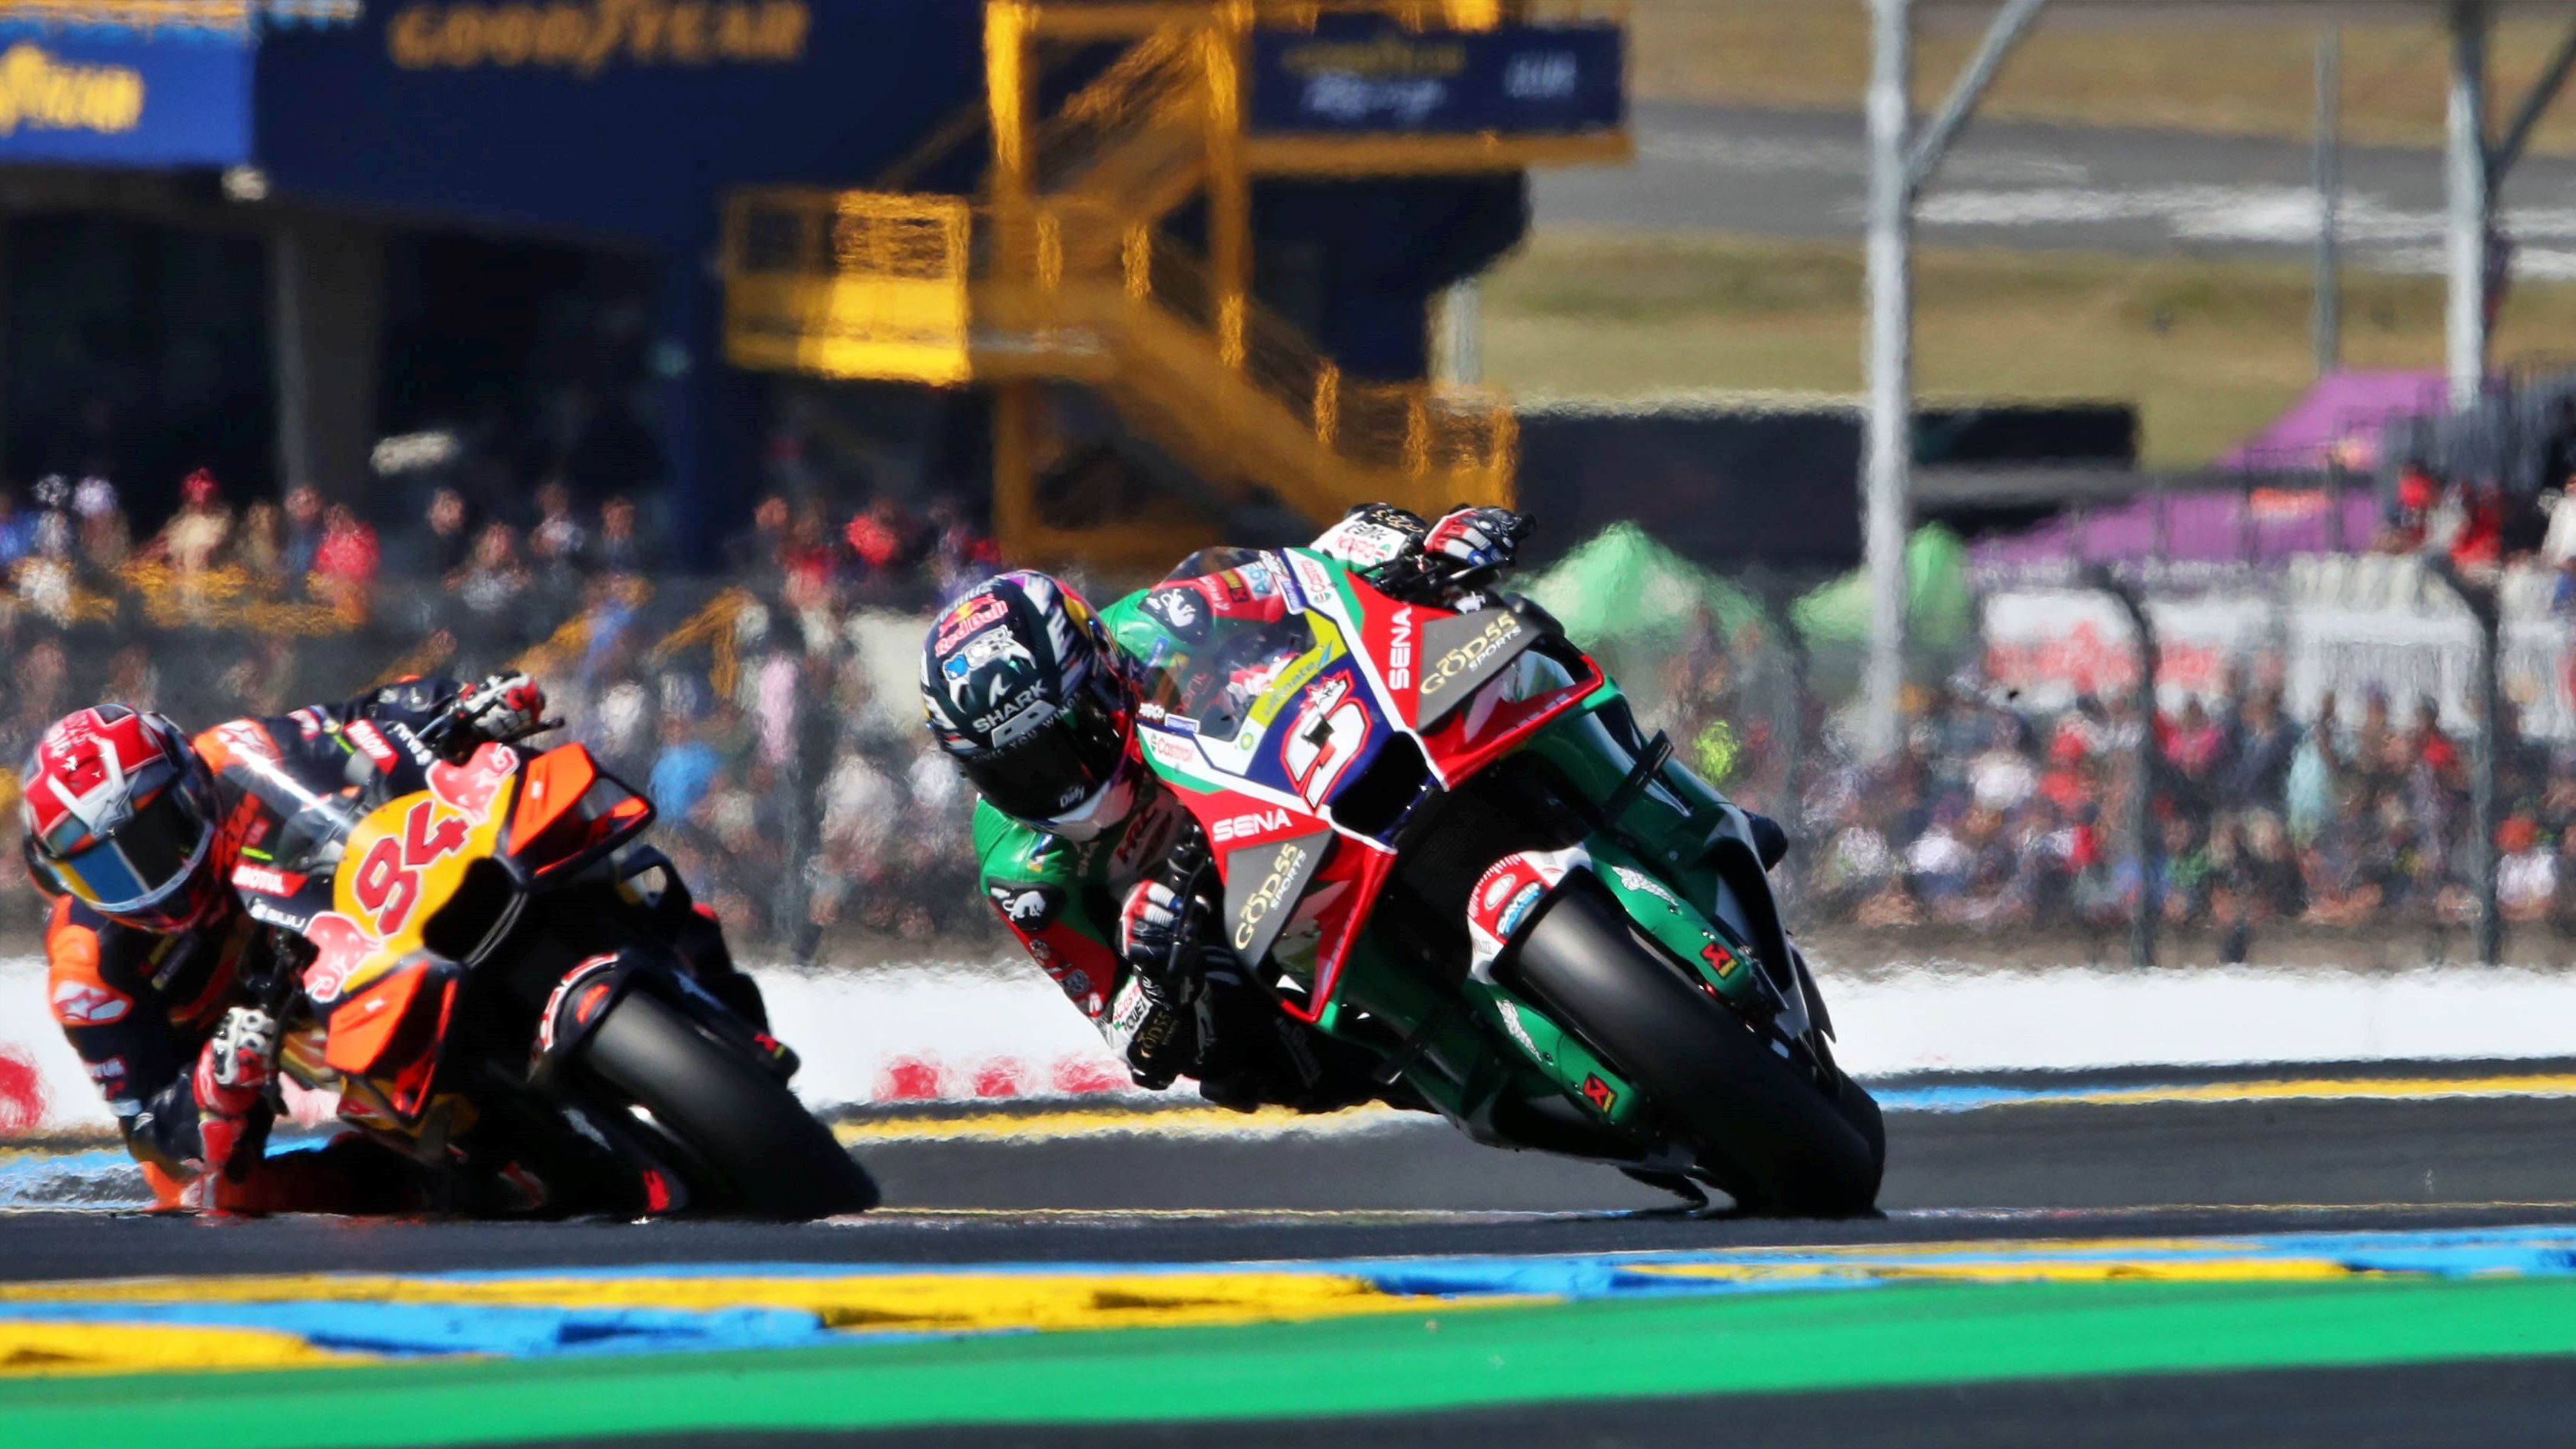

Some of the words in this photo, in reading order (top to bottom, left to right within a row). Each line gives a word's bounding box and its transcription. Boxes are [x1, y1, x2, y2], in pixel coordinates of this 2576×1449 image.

[935, 619, 970, 658] Red
[967, 600, 1009, 632] Bull
[1389, 606, 1413, 691] SENA
[1468, 625, 1522, 671] SPORTS
[972, 678, 1048, 733] SHARK
[1213, 808, 1293, 842] SENA
[232, 864, 285, 894] MOTUL
[355, 799, 474, 938] 94
[1270, 849, 1306, 910] SPORTS
